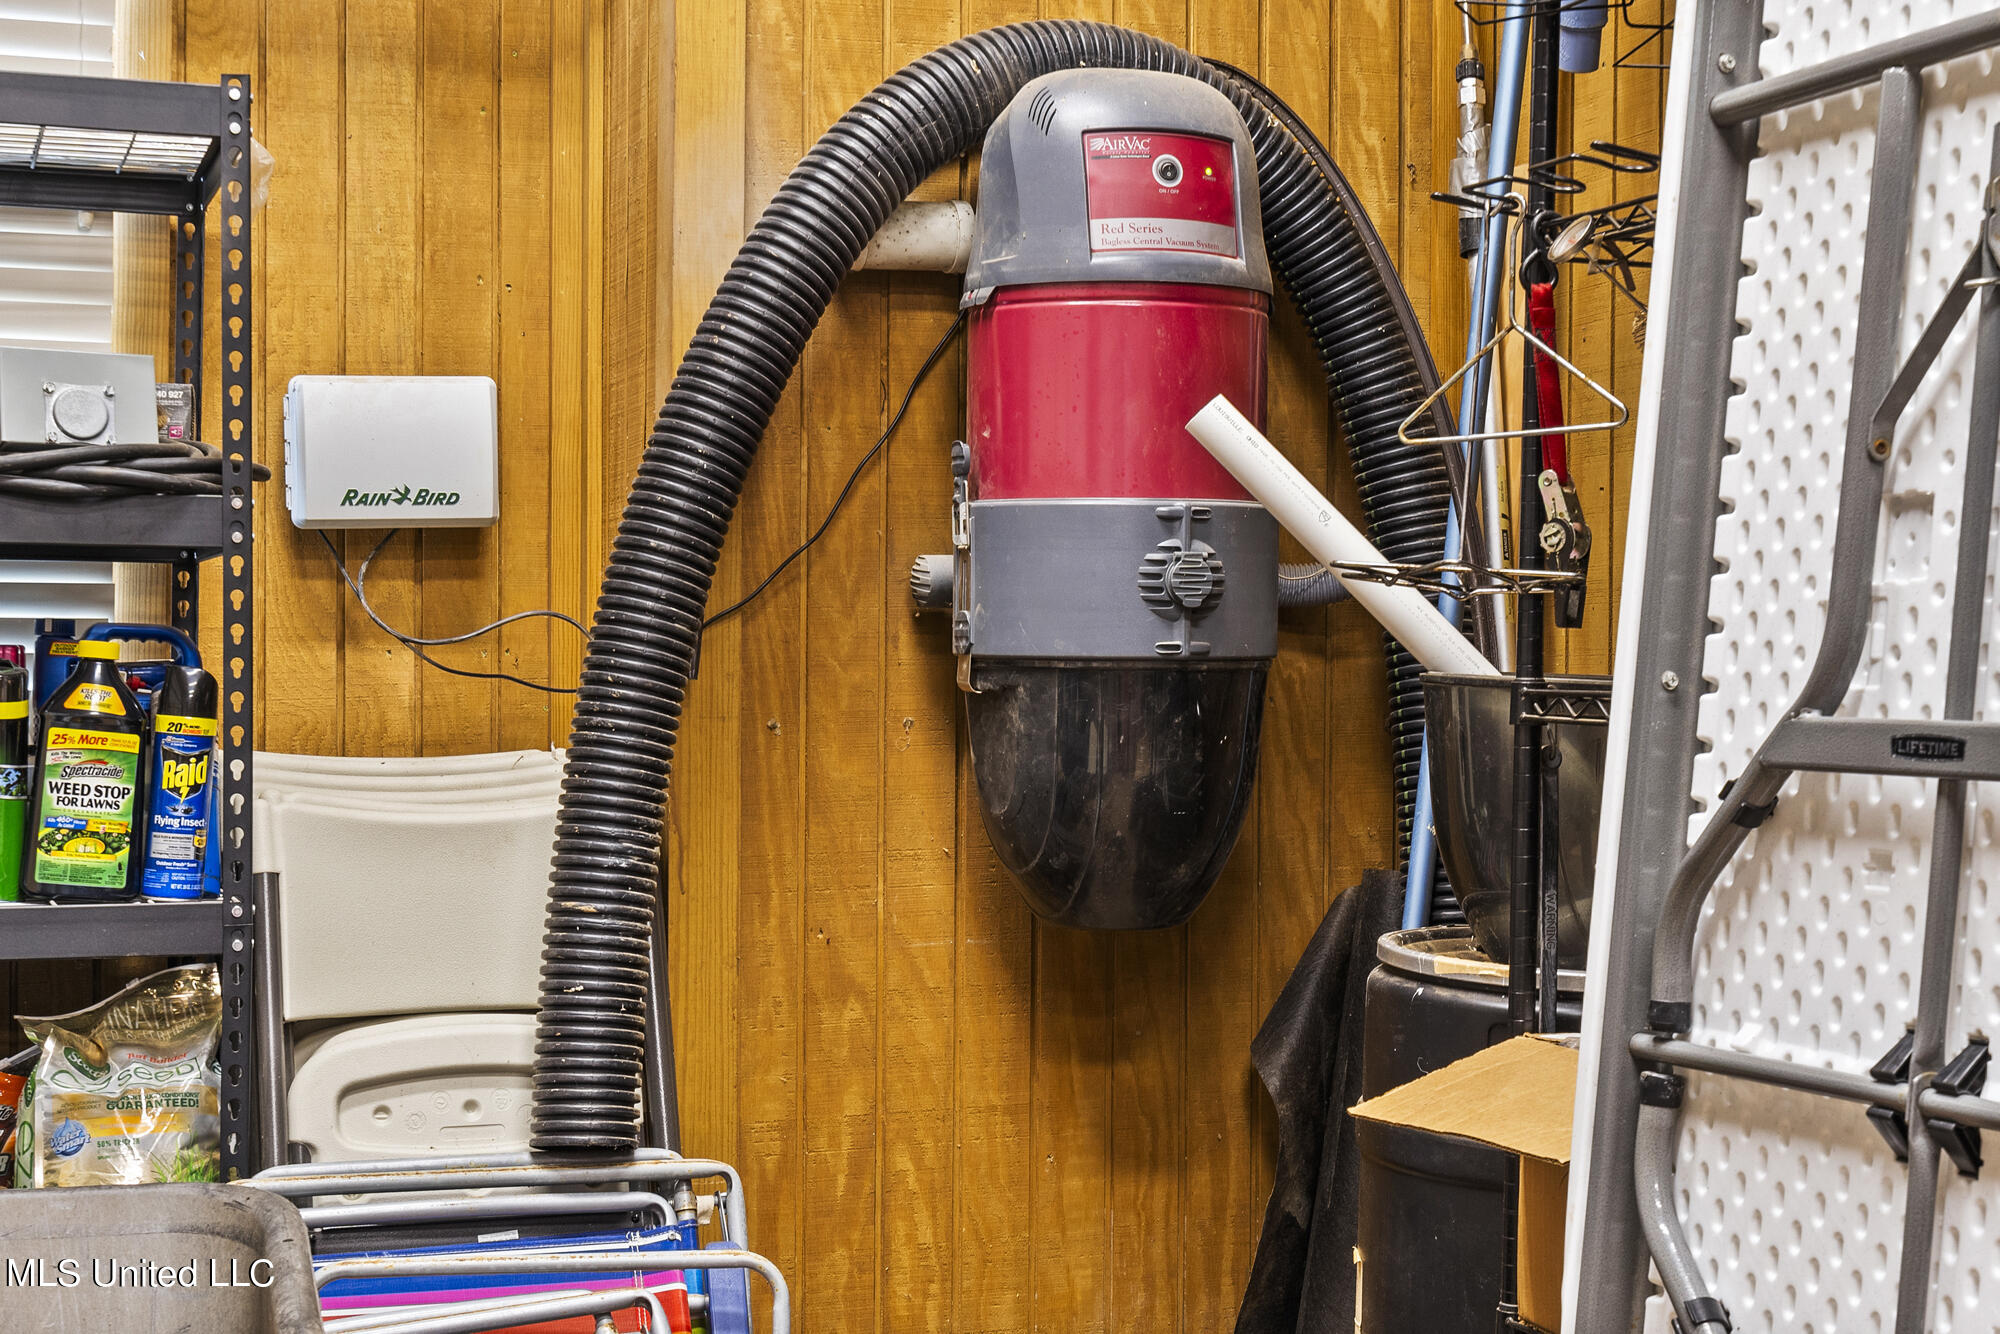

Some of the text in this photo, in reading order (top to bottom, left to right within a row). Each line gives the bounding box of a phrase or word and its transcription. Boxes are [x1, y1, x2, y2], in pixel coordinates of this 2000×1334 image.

[1101, 222, 1164, 235] Red Series
[1101, 236, 1221, 251] Bagless Central Vacuum System
[168, 390, 183, 399] 927
[340, 488, 461, 507] RAIN BIRD
[77, 734, 108, 746] More
[1897, 739, 1959, 757] LIFETIME
[61, 765, 124, 779] Spectracide
[162, 755, 208, 790] Raid
[49, 781, 131, 800] WEED STOP
[56, 796, 121, 810] FOR LAWNS
[154, 815, 205, 828] Flying Insect
[1544, 889, 1557, 951] WARNING
[106, 1098, 199, 1110] GUARANTEED!
[50, 1130, 82, 1148] Water
